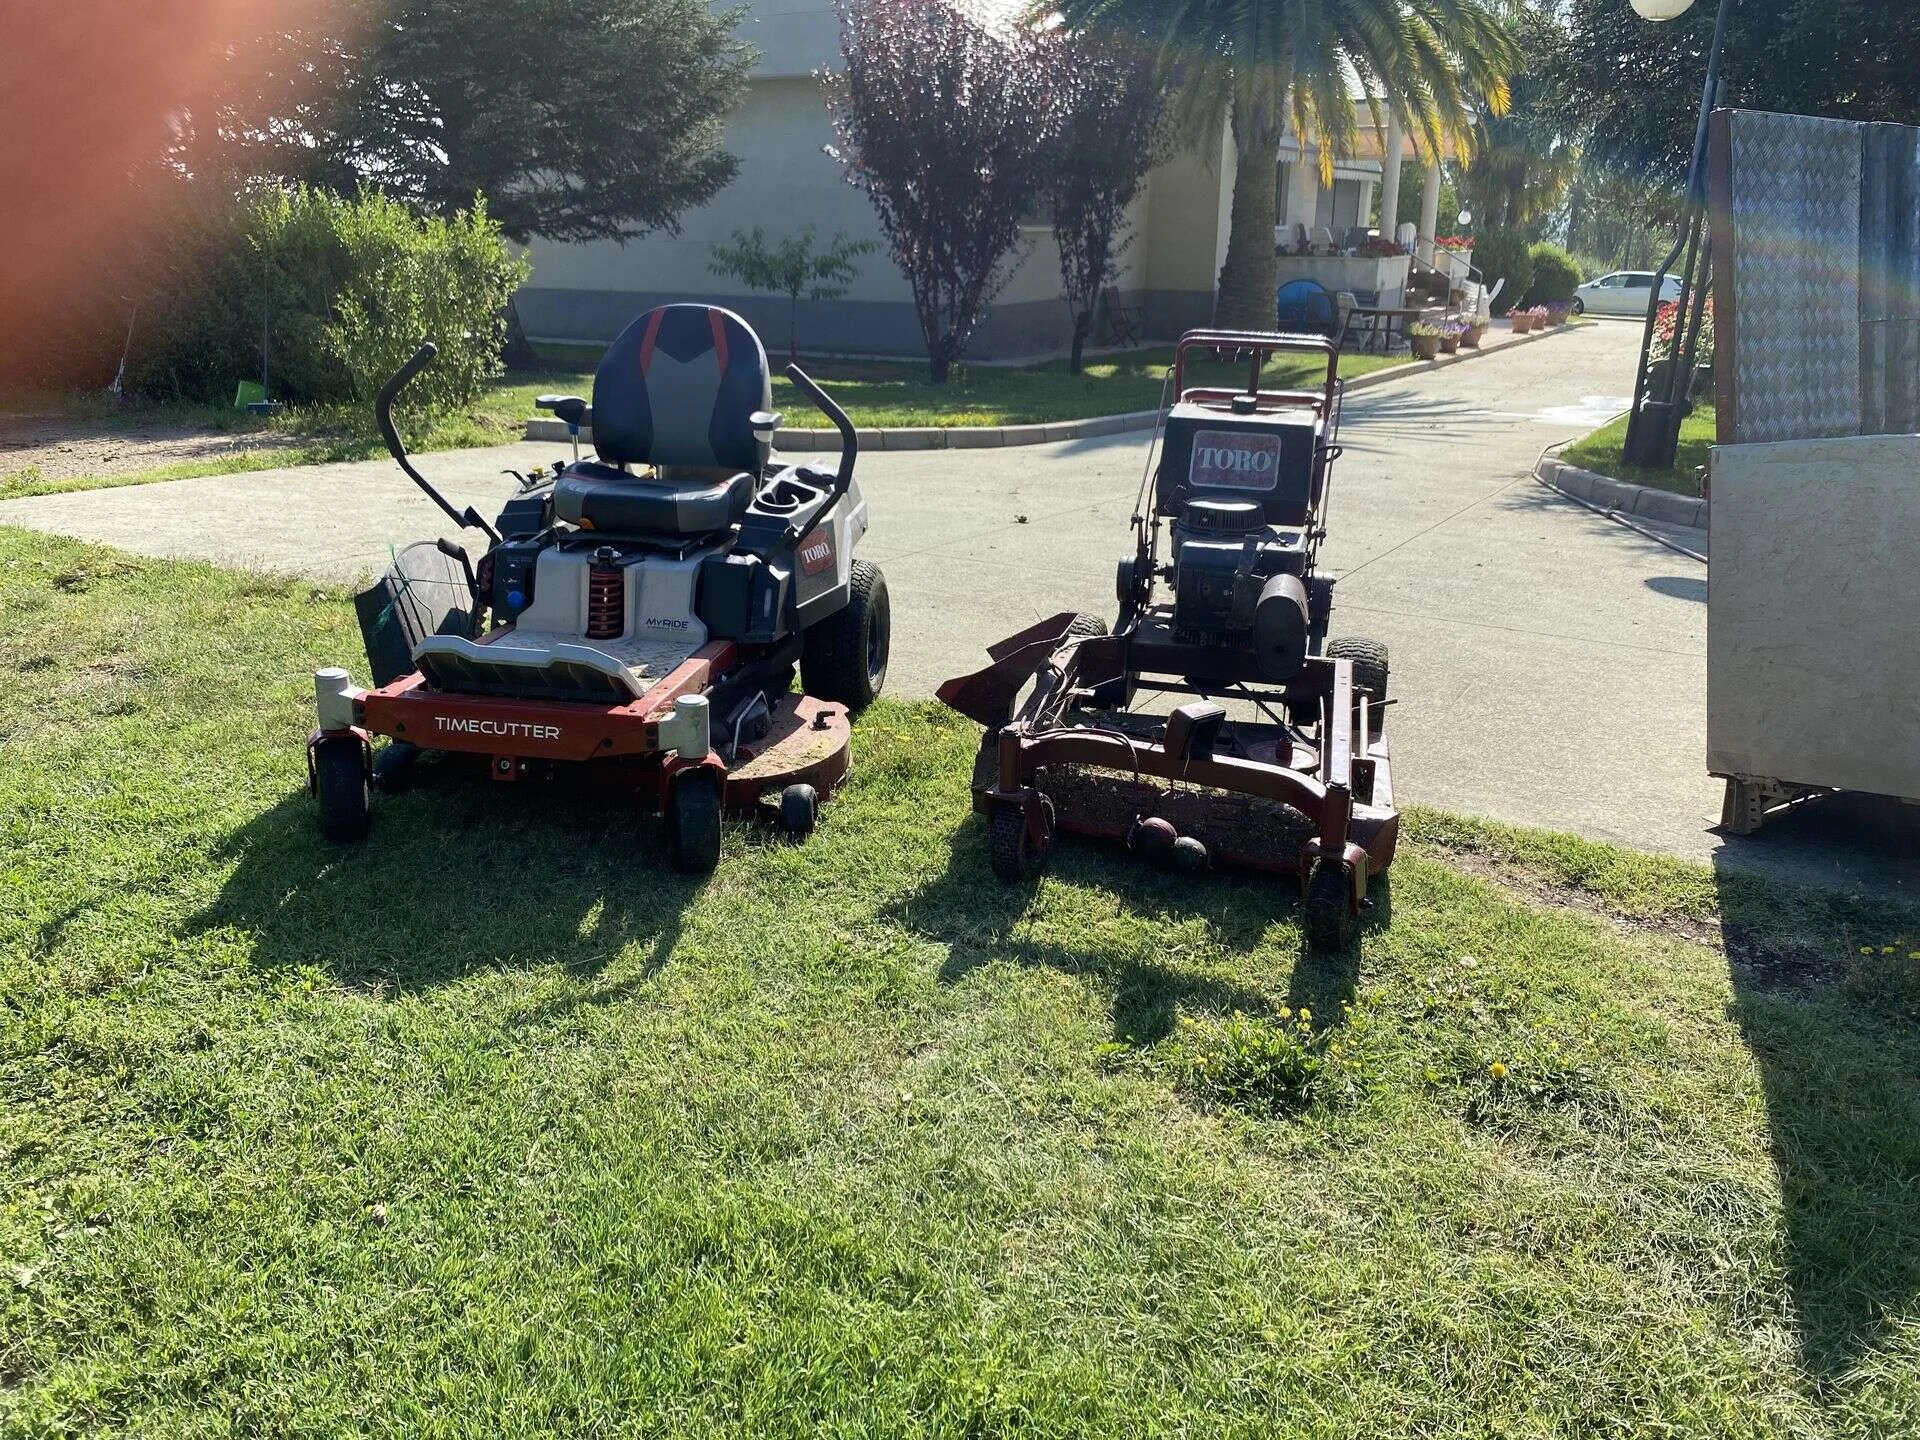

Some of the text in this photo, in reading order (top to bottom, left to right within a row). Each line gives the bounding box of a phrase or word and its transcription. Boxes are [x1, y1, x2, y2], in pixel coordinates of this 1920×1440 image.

[1197, 447, 1271, 472] TORO
[802, 542, 829, 564] TORO
[434, 716, 560, 740] TIMECUTTER
